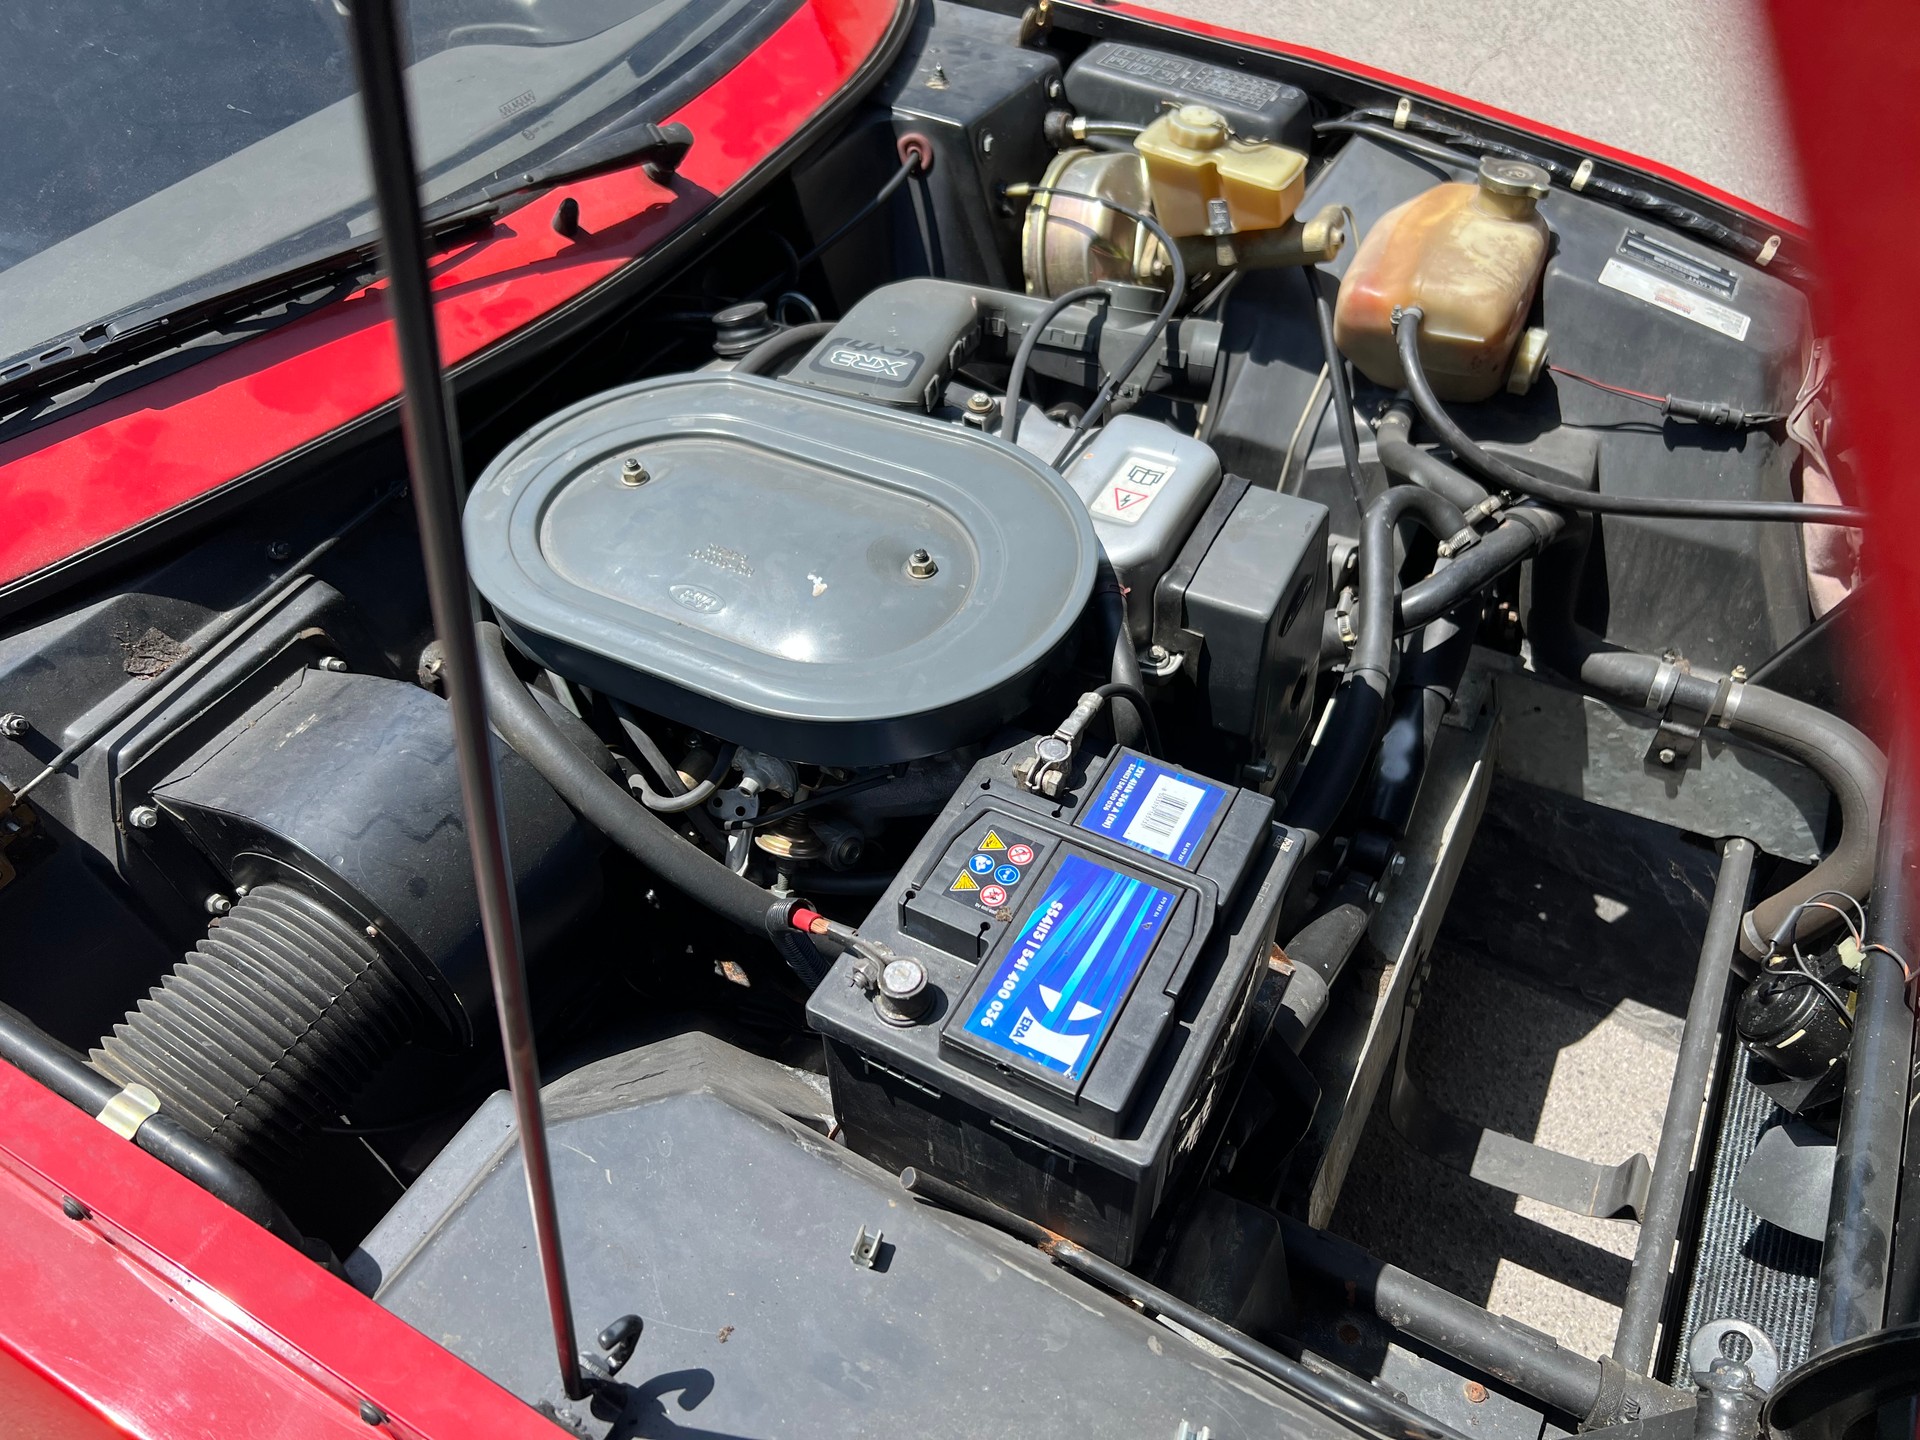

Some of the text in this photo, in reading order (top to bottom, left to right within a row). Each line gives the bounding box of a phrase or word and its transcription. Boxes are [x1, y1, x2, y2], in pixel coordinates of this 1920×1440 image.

[830, 350, 908, 376] XR3
[1136, 766, 1146, 779] 12V
[1111, 806, 1120, 814] A
[1116, 792, 1129, 808] 360
[1014, 948, 1034, 972] 541
[997, 970, 1020, 1000] 400
[980, 1001, 1004, 1029] 036
[1012, 1016, 1033, 1040] ERA
